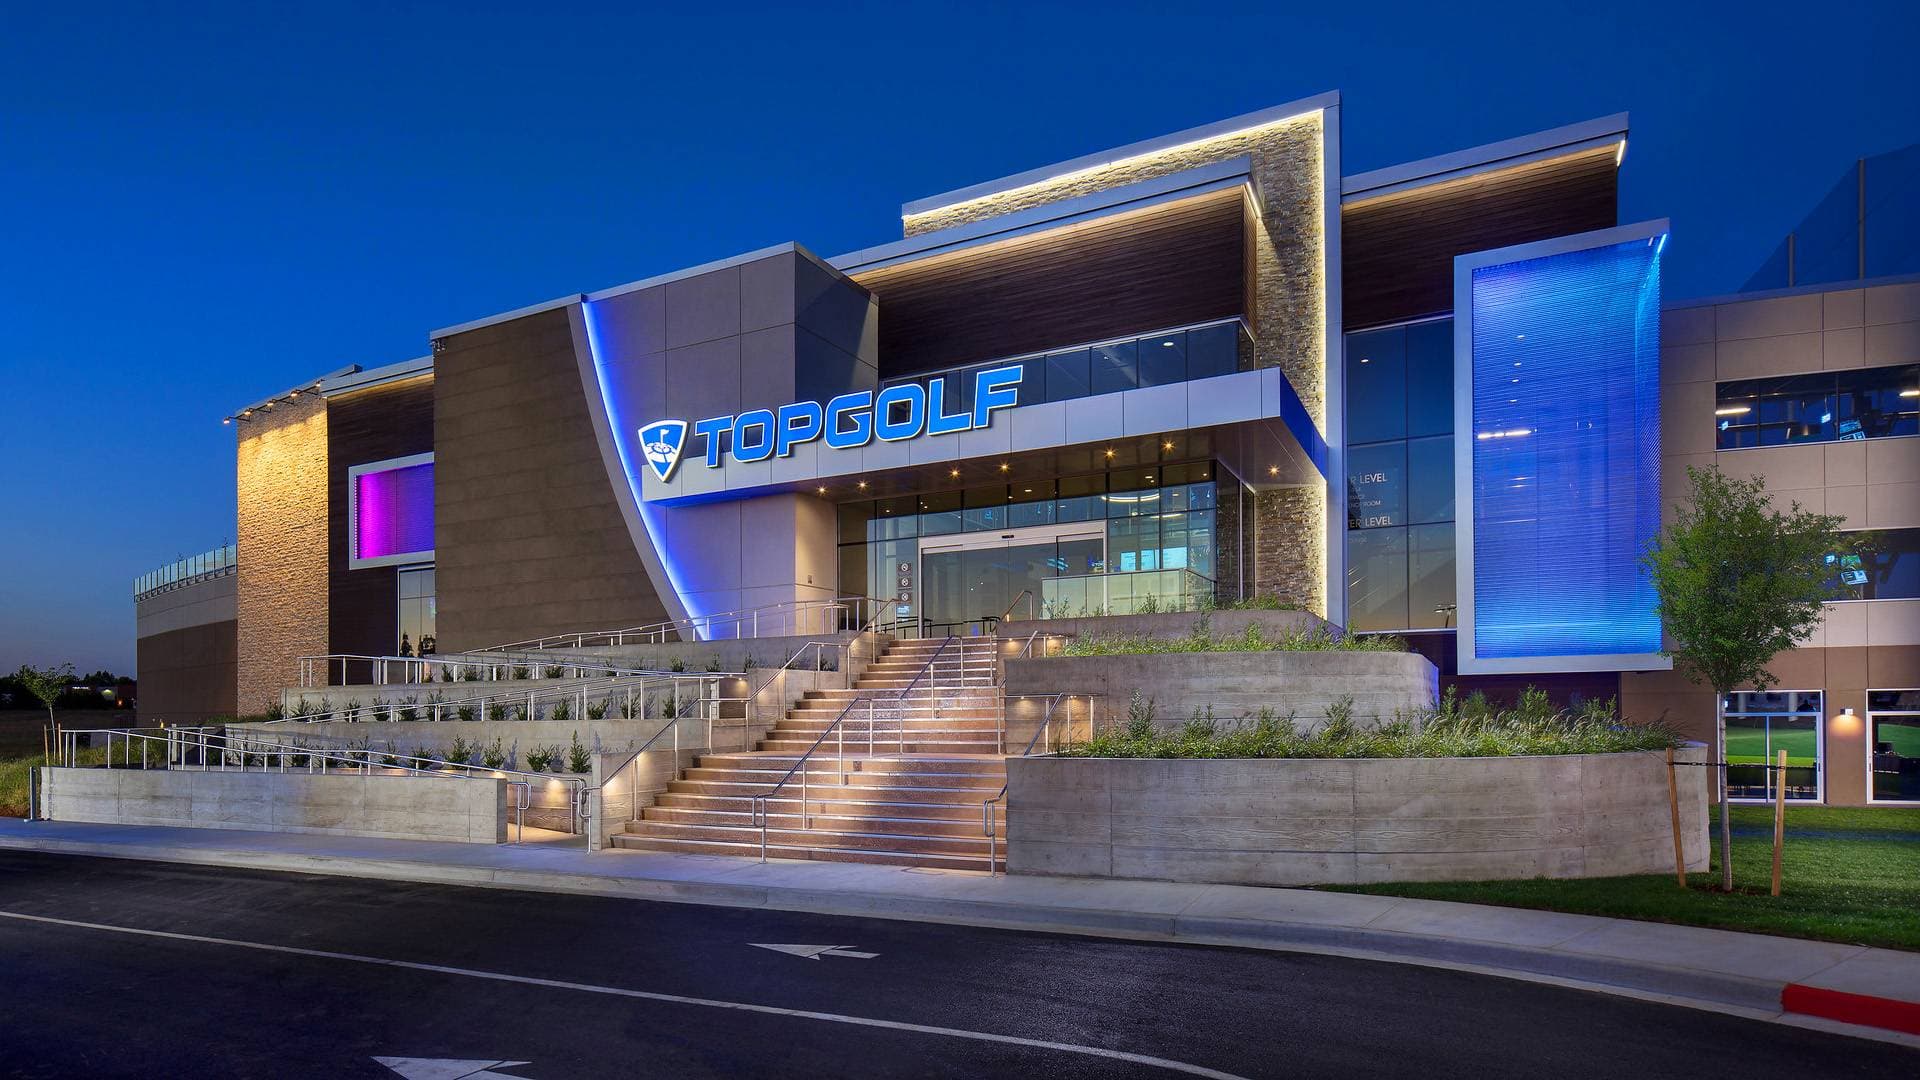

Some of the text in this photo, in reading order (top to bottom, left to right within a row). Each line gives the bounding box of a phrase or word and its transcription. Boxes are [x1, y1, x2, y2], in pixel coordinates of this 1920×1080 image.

[695, 365, 1024, 468] TOPGOLF
[1360, 473, 1387, 483] LEVEL
[1365, 516, 1392, 527] LEVEL
